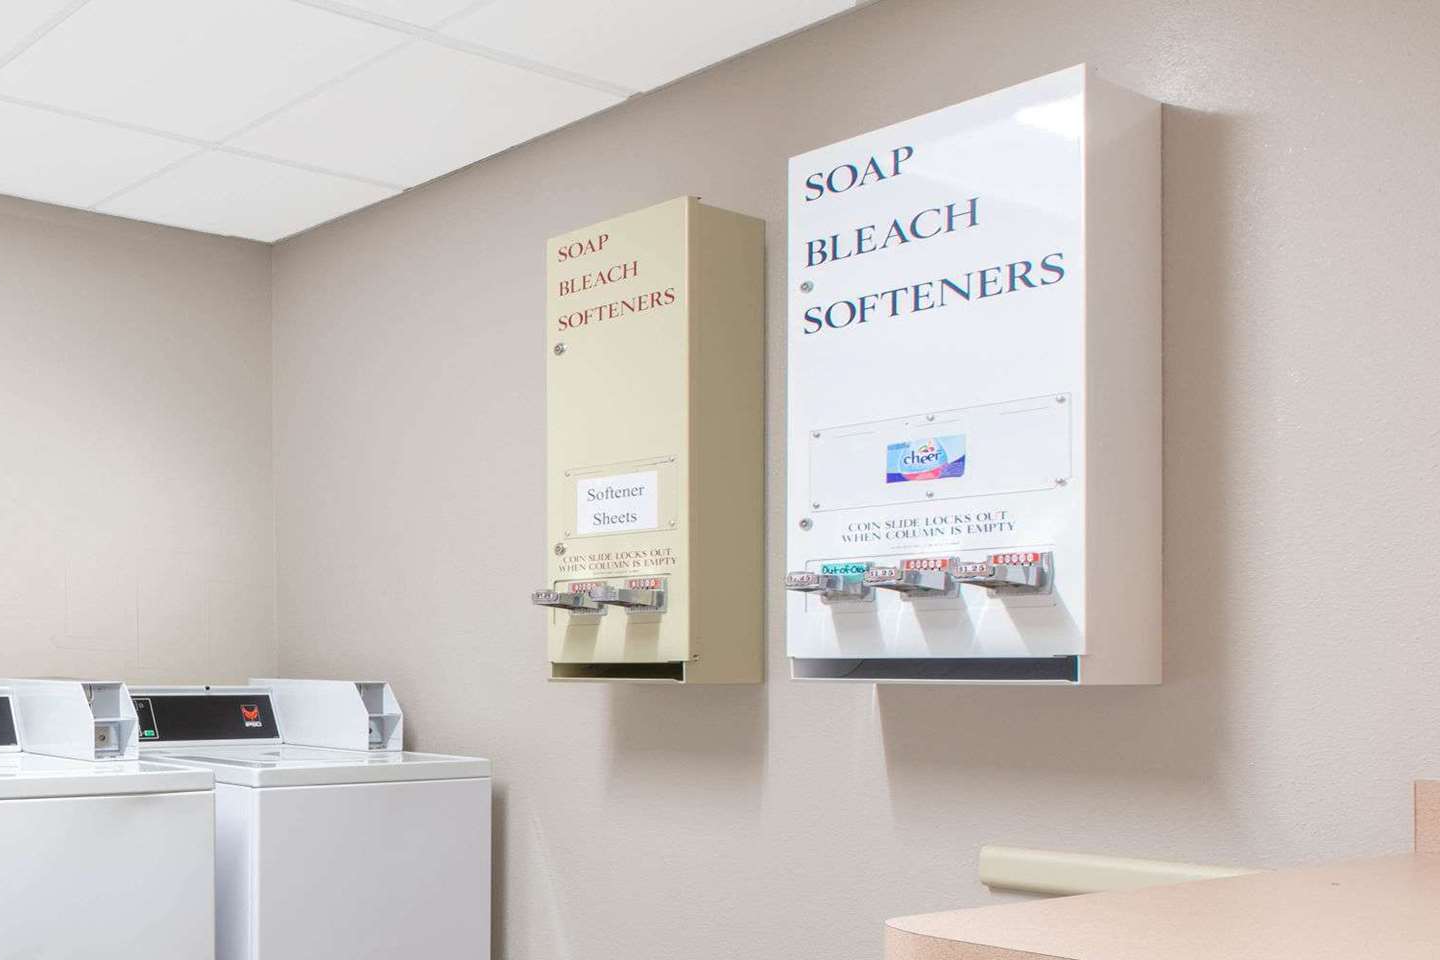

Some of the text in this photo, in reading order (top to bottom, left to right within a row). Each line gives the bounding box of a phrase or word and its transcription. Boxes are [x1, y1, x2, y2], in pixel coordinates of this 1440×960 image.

[804, 144, 915, 202] SOAP
[805, 197, 981, 269] BLEACH
[557, 233, 610, 263] SOAP
[559, 260, 639, 297] BLEACH
[802, 252, 1066, 336] SOFTENERS
[557, 287, 676, 332] SOFTENERS
[903, 450, 942, 465] cheer
[586, 485, 646, 502] Softener
[592, 510, 638, 526] Sheets
[848, 511, 1008, 532] COIN SLIDE LOCKS OUT
[841, 521, 1016, 543] WHEN COLUMN IS EMPTY
[558, 563, 587, 573] WHEN
[589, 559, 630, 570] COLUMN
[633, 559, 641, 568] IS
[644, 557, 677, 567] EMPTY
[563, 547, 673, 564] COIN SLIDE LOCKS OUT
